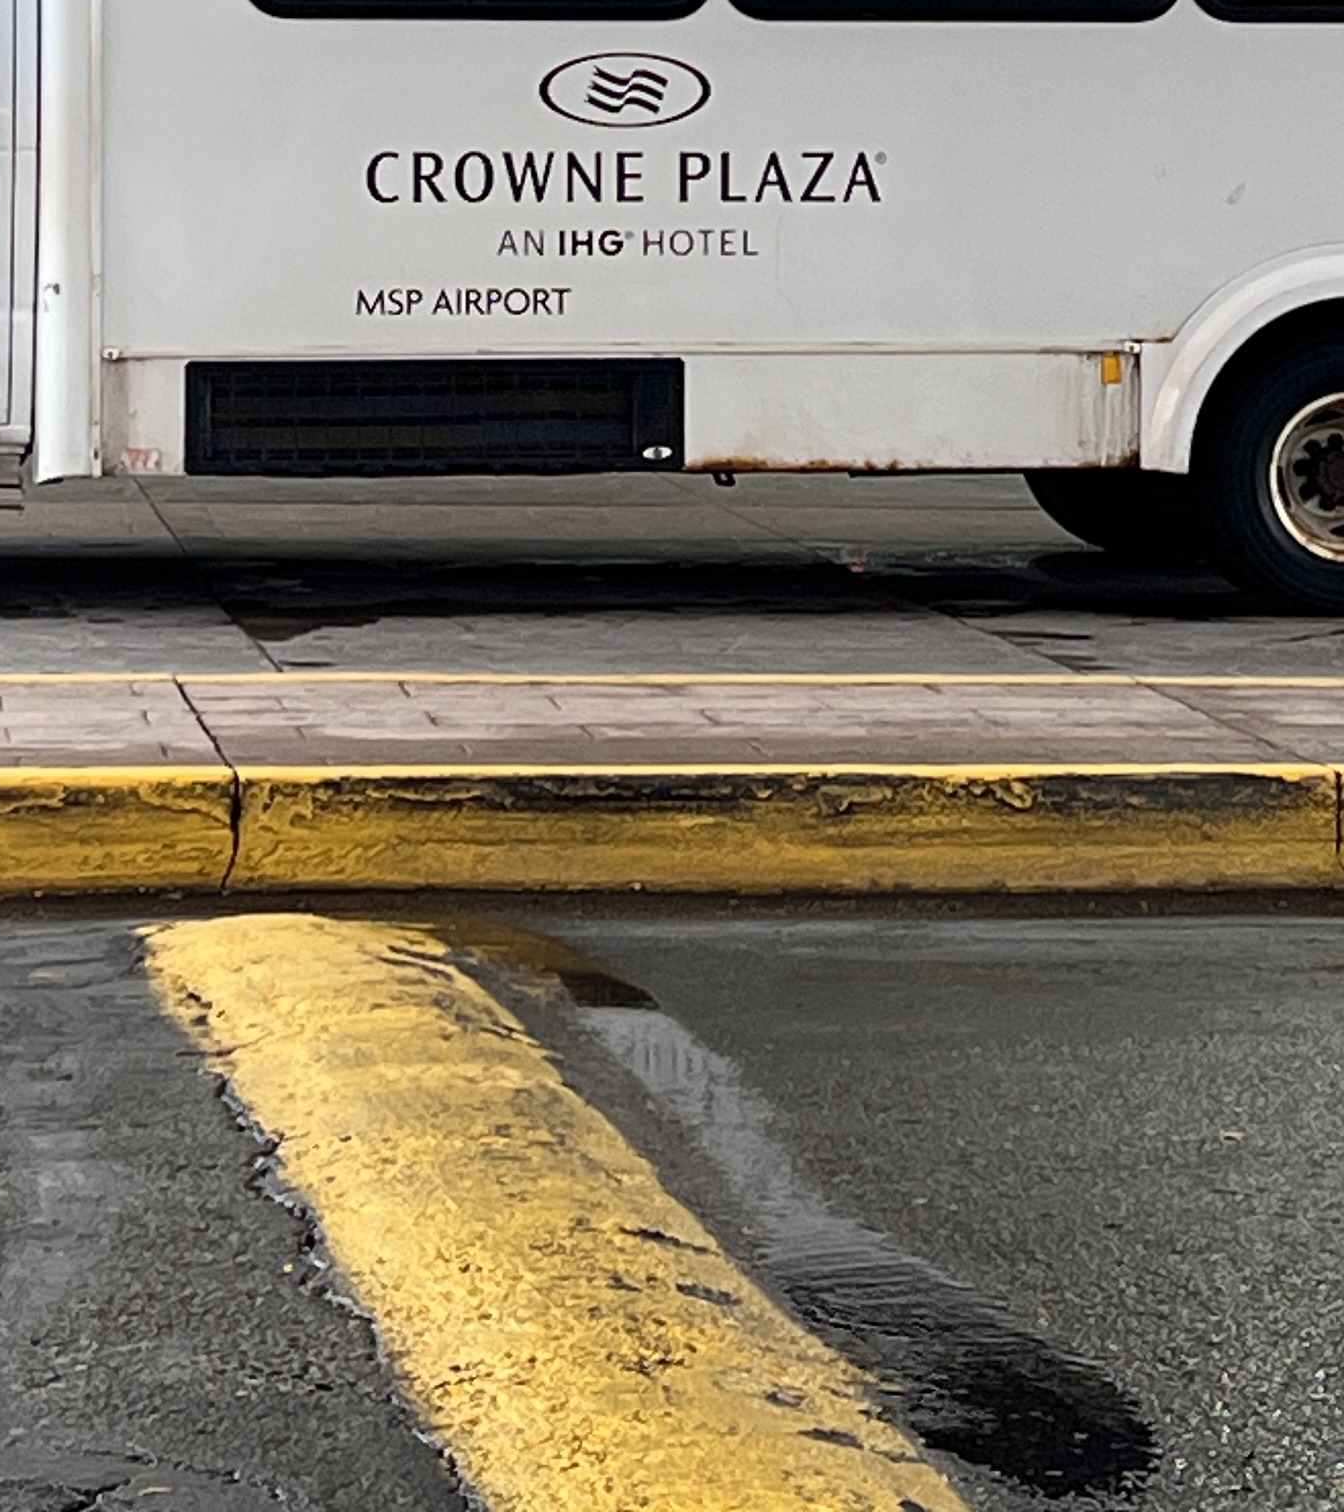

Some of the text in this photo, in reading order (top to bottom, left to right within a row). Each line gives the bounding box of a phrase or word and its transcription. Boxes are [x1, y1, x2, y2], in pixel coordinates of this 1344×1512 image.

[365, 150, 645, 204] CROWNE
[496, 229, 545, 257] AN
[642, 228, 760, 257] HOTEL
[354, 287, 573, 317] MSP AIRPORT
